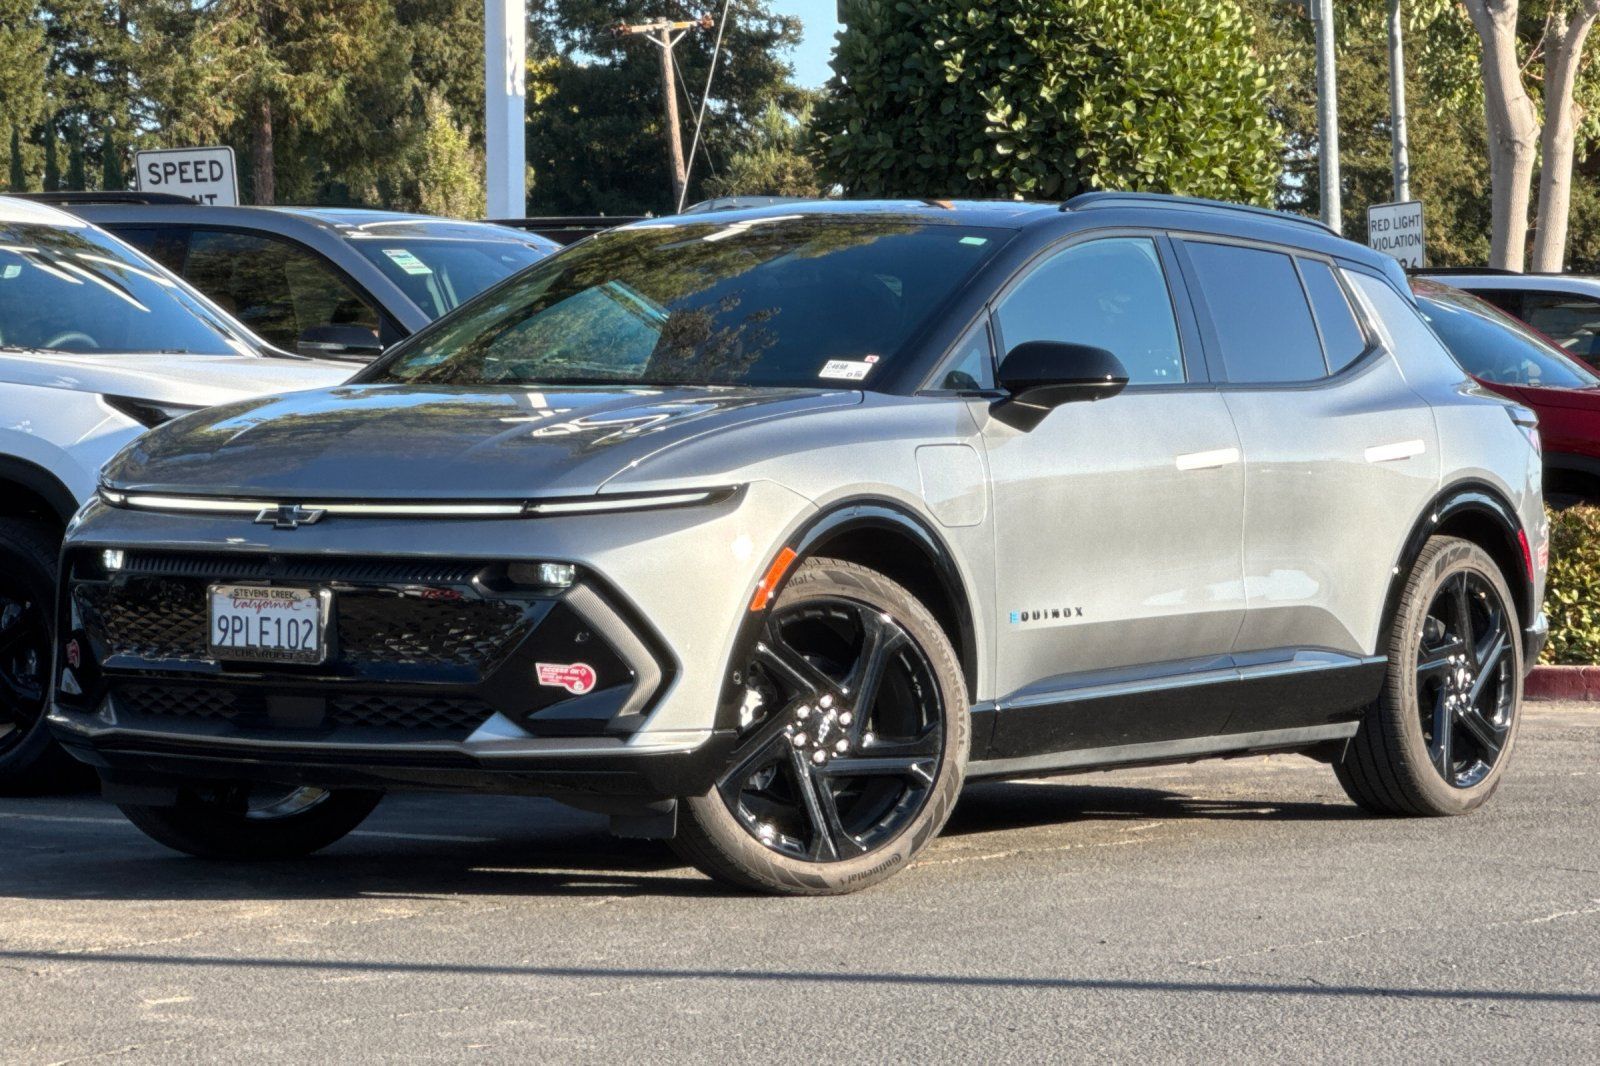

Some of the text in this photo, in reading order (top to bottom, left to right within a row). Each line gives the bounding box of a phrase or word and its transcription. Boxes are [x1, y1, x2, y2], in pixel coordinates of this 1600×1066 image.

[147, 159, 224, 185] SPEED
[1371, 214, 1420, 232] RED LIGHT
[1372, 233, 1421, 251] VIOLATION
[233, 588, 295, 600] STEVENS CREEK
[232, 598, 300, 614] California
[1009, 606, 1084, 625] EQUINOX
[217, 614, 314, 650] 9PLE102
